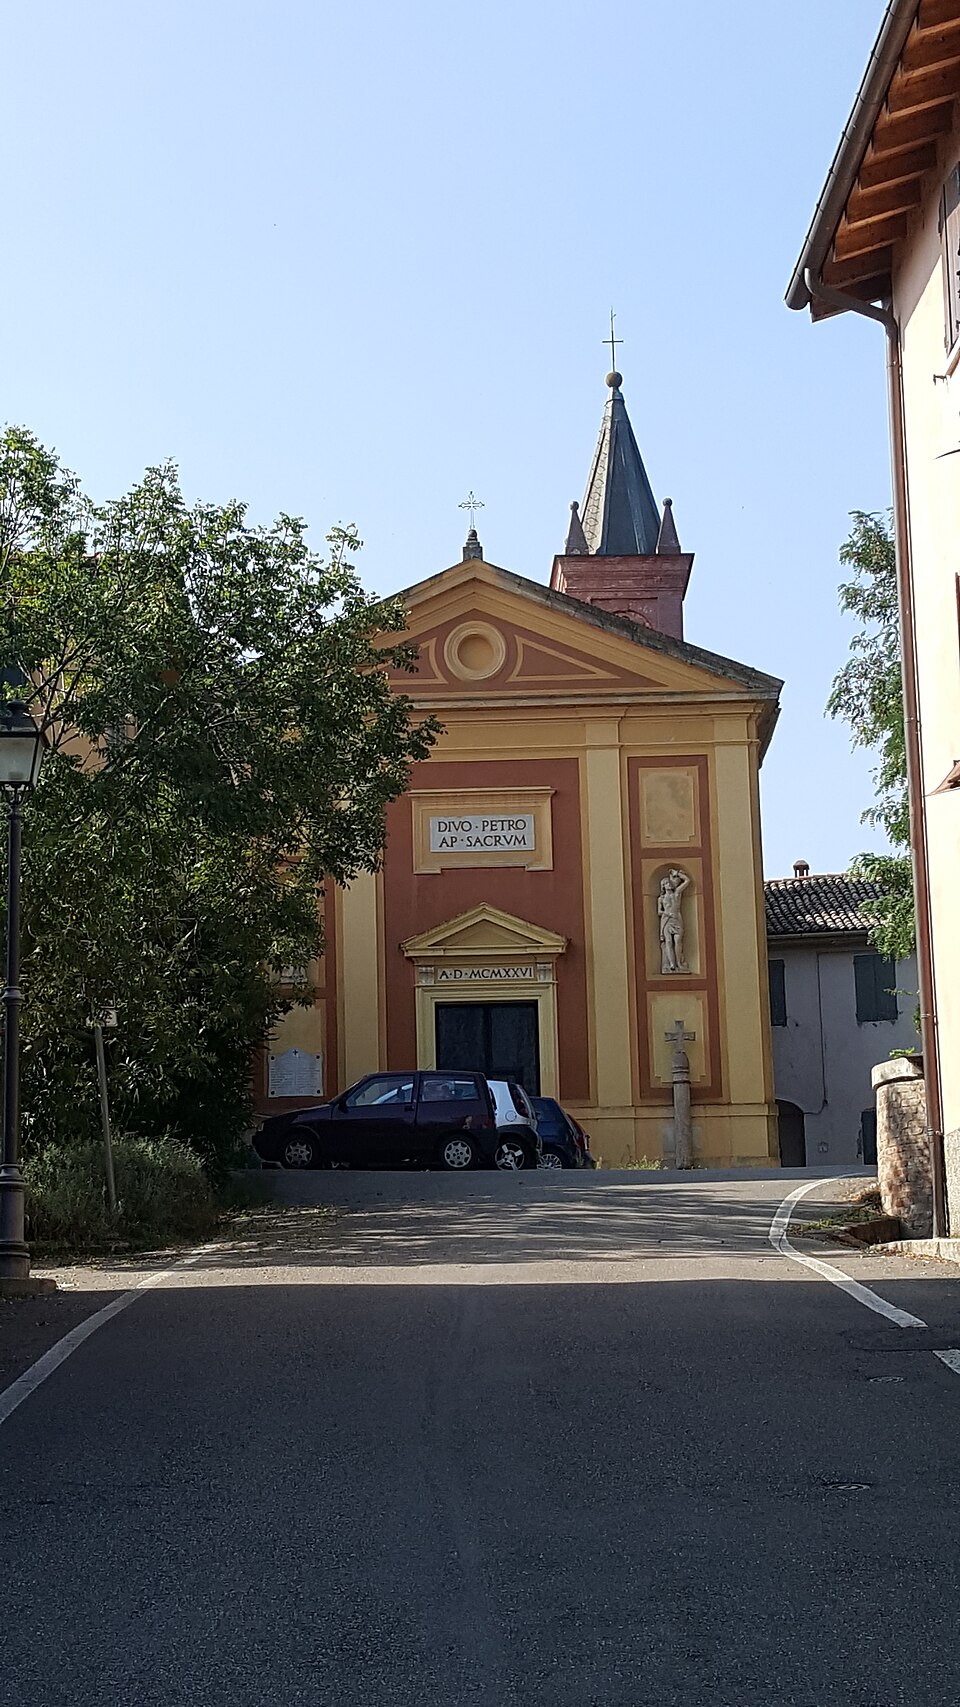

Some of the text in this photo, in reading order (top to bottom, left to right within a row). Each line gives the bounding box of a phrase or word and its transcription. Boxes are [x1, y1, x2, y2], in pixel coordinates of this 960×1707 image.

[437, 818, 527, 833] DIVO PETRO
[465, 834, 527, 848] SACRVM
